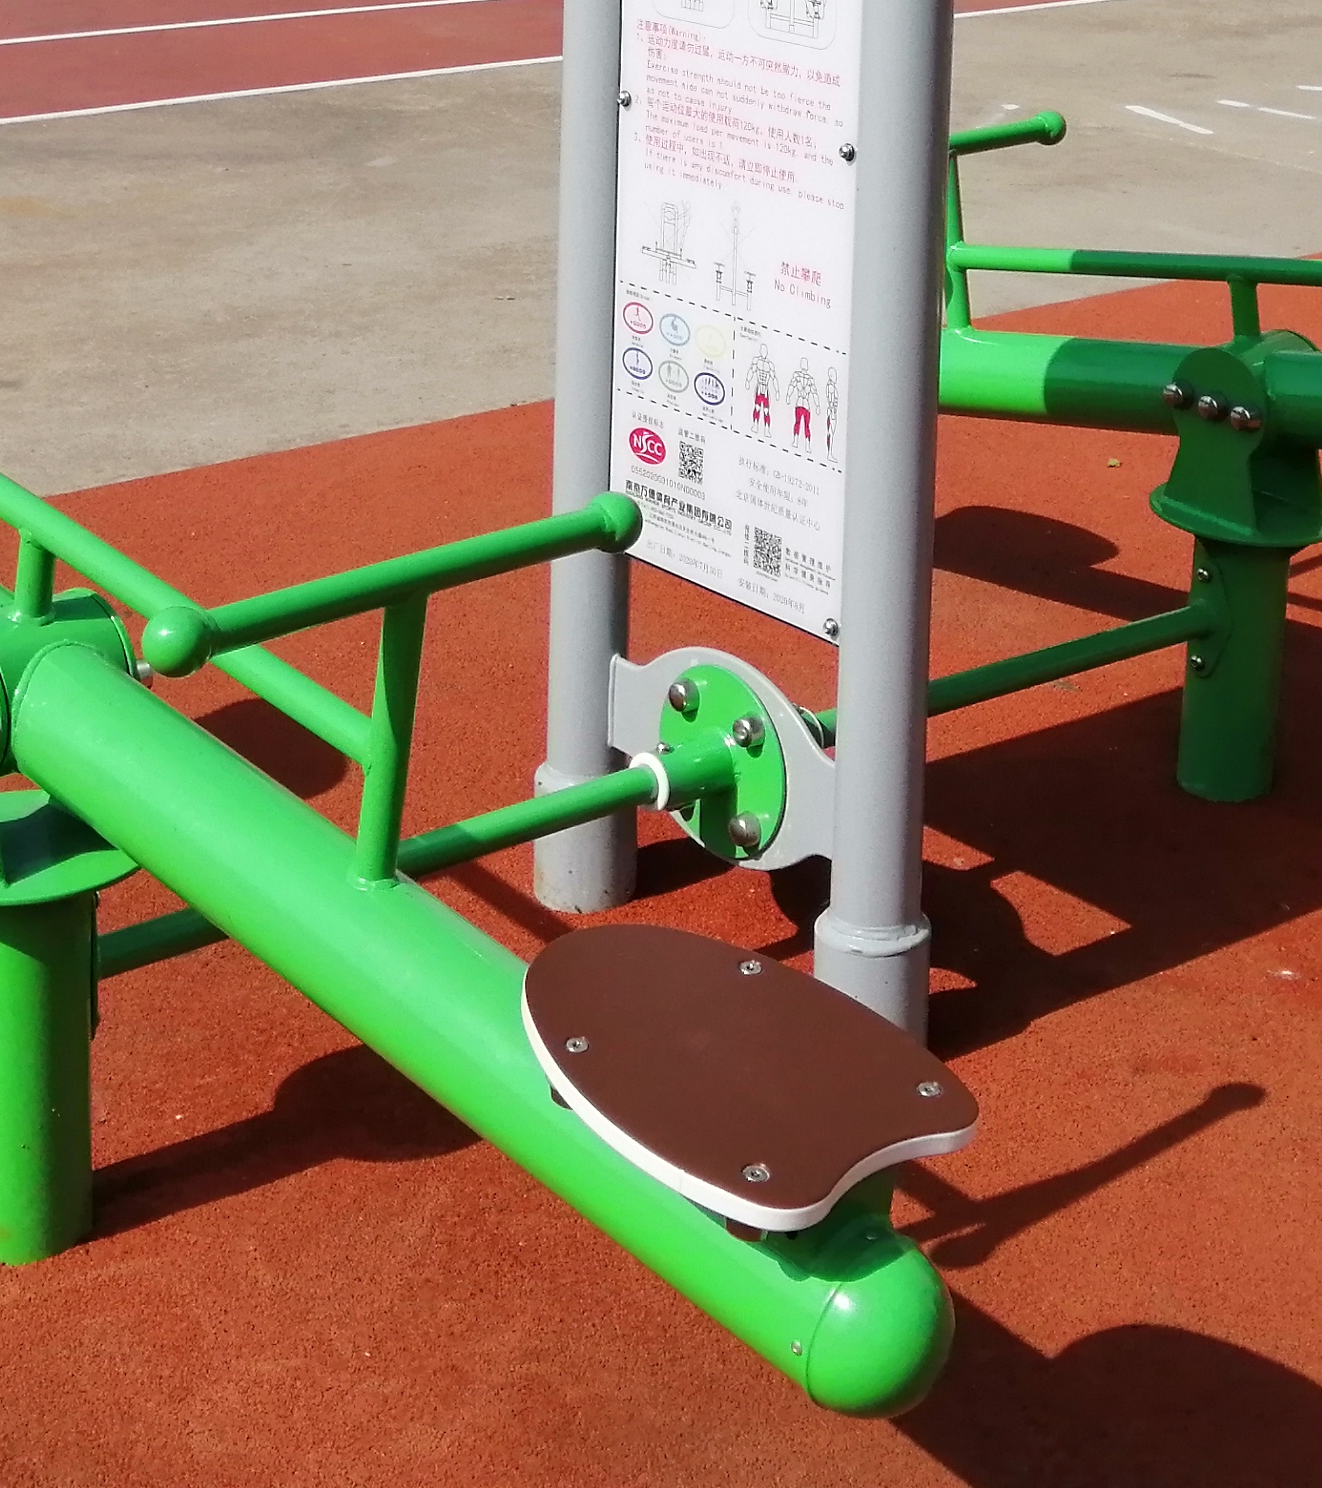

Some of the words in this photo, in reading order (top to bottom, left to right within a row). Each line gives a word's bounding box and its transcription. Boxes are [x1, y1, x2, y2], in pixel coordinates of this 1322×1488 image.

[646, 71, 678, 88] movement
[700, 86, 713, 96] can
[716, 88, 728, 100] not
[732, 92, 765, 110] suddenly
[646, 86, 654, 95] as
[657, 88, 669, 99] not
[674, 92, 681, 101] to
[647, 58, 678, 75] Exercise
[682, 66, 713, 85] strength
[716, 75, 741, 90] should
[744, 83, 756, 94] not
[760, 86, 768, 96] be
[773, 89, 785, 101] too
[790, 91, 814, 107] fierce
[818, 99, 830, 111] the
[645, 122, 668, 136] number
[672, 128, 681, 140] of
[684, 133, 703, 146] users
[646, 109, 657, 120] The
[660, 113, 689, 129] maximum
[693, 121, 708, 134] load
[711, 127, 722, 138] per
[726, 130, 759, 147] movement
[803, 149, 817, 162] and
[820, 153, 833, 166] the
[644, 160, 664, 175] using
[668, 166, 675, 176] it
[645, 147, 652, 157] If
[656, 150, 676, 164] there
[691, 161, 703, 172] any
[706, 163, 745, 183] discomfort
[749, 175, 774, 192] during
[798, 189, 823, 204] please
[827, 197, 844, 211] stop
[780, 260, 821, 287] 禁止攀爬
[774, 278, 785, 292] No
[789, 282, 831, 310] Climbing
[633, 429, 662, 457] NSCC
